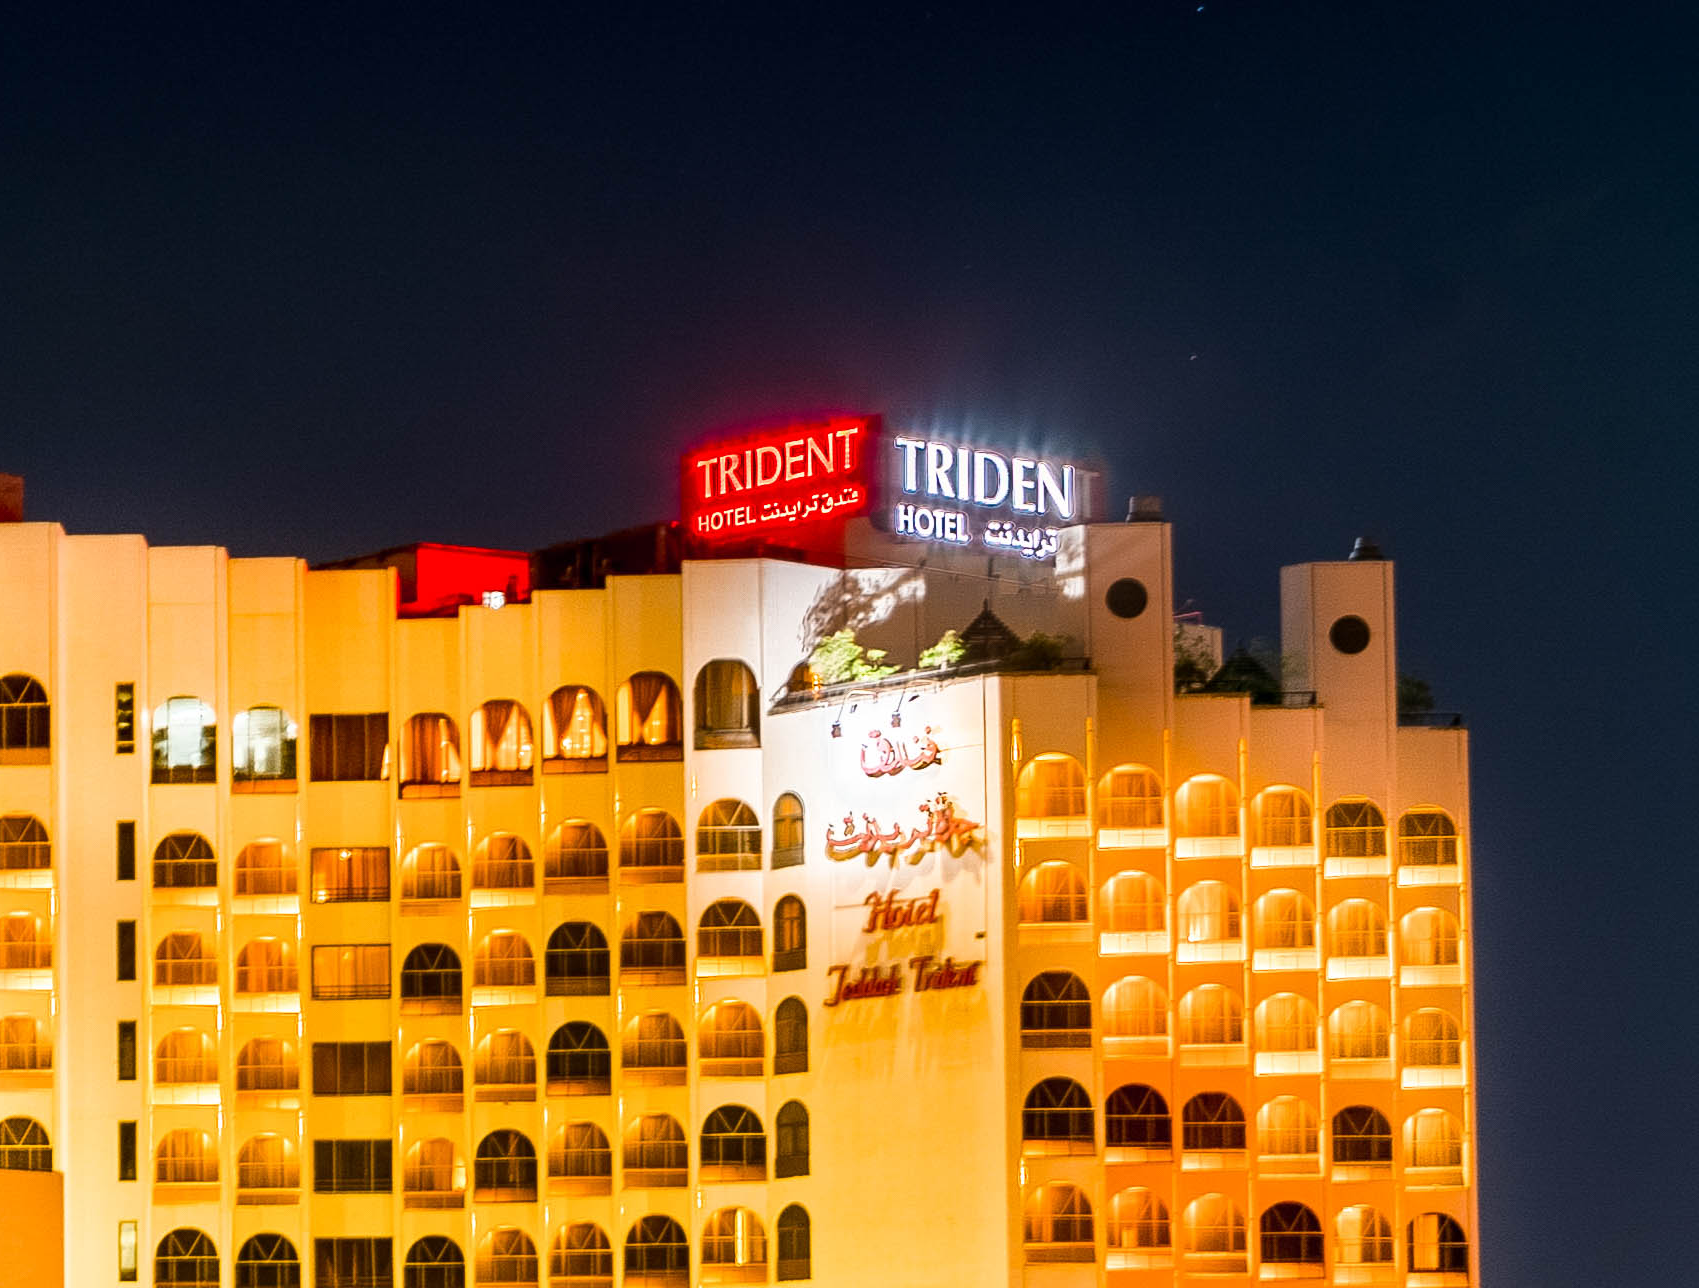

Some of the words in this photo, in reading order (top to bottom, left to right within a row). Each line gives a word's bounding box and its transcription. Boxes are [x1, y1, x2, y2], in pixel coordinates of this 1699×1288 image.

[697, 427, 859, 499] TRIDENT
[894, 435, 1077, 521] TRIDEN
[698, 506, 757, 532] HOTEL
[760, 495, 820, 522] ترايدنت
[820, 487, 859, 514] فندق
[896, 503, 972, 545] HOTEL
[862, 888, 940, 933] Hotel
